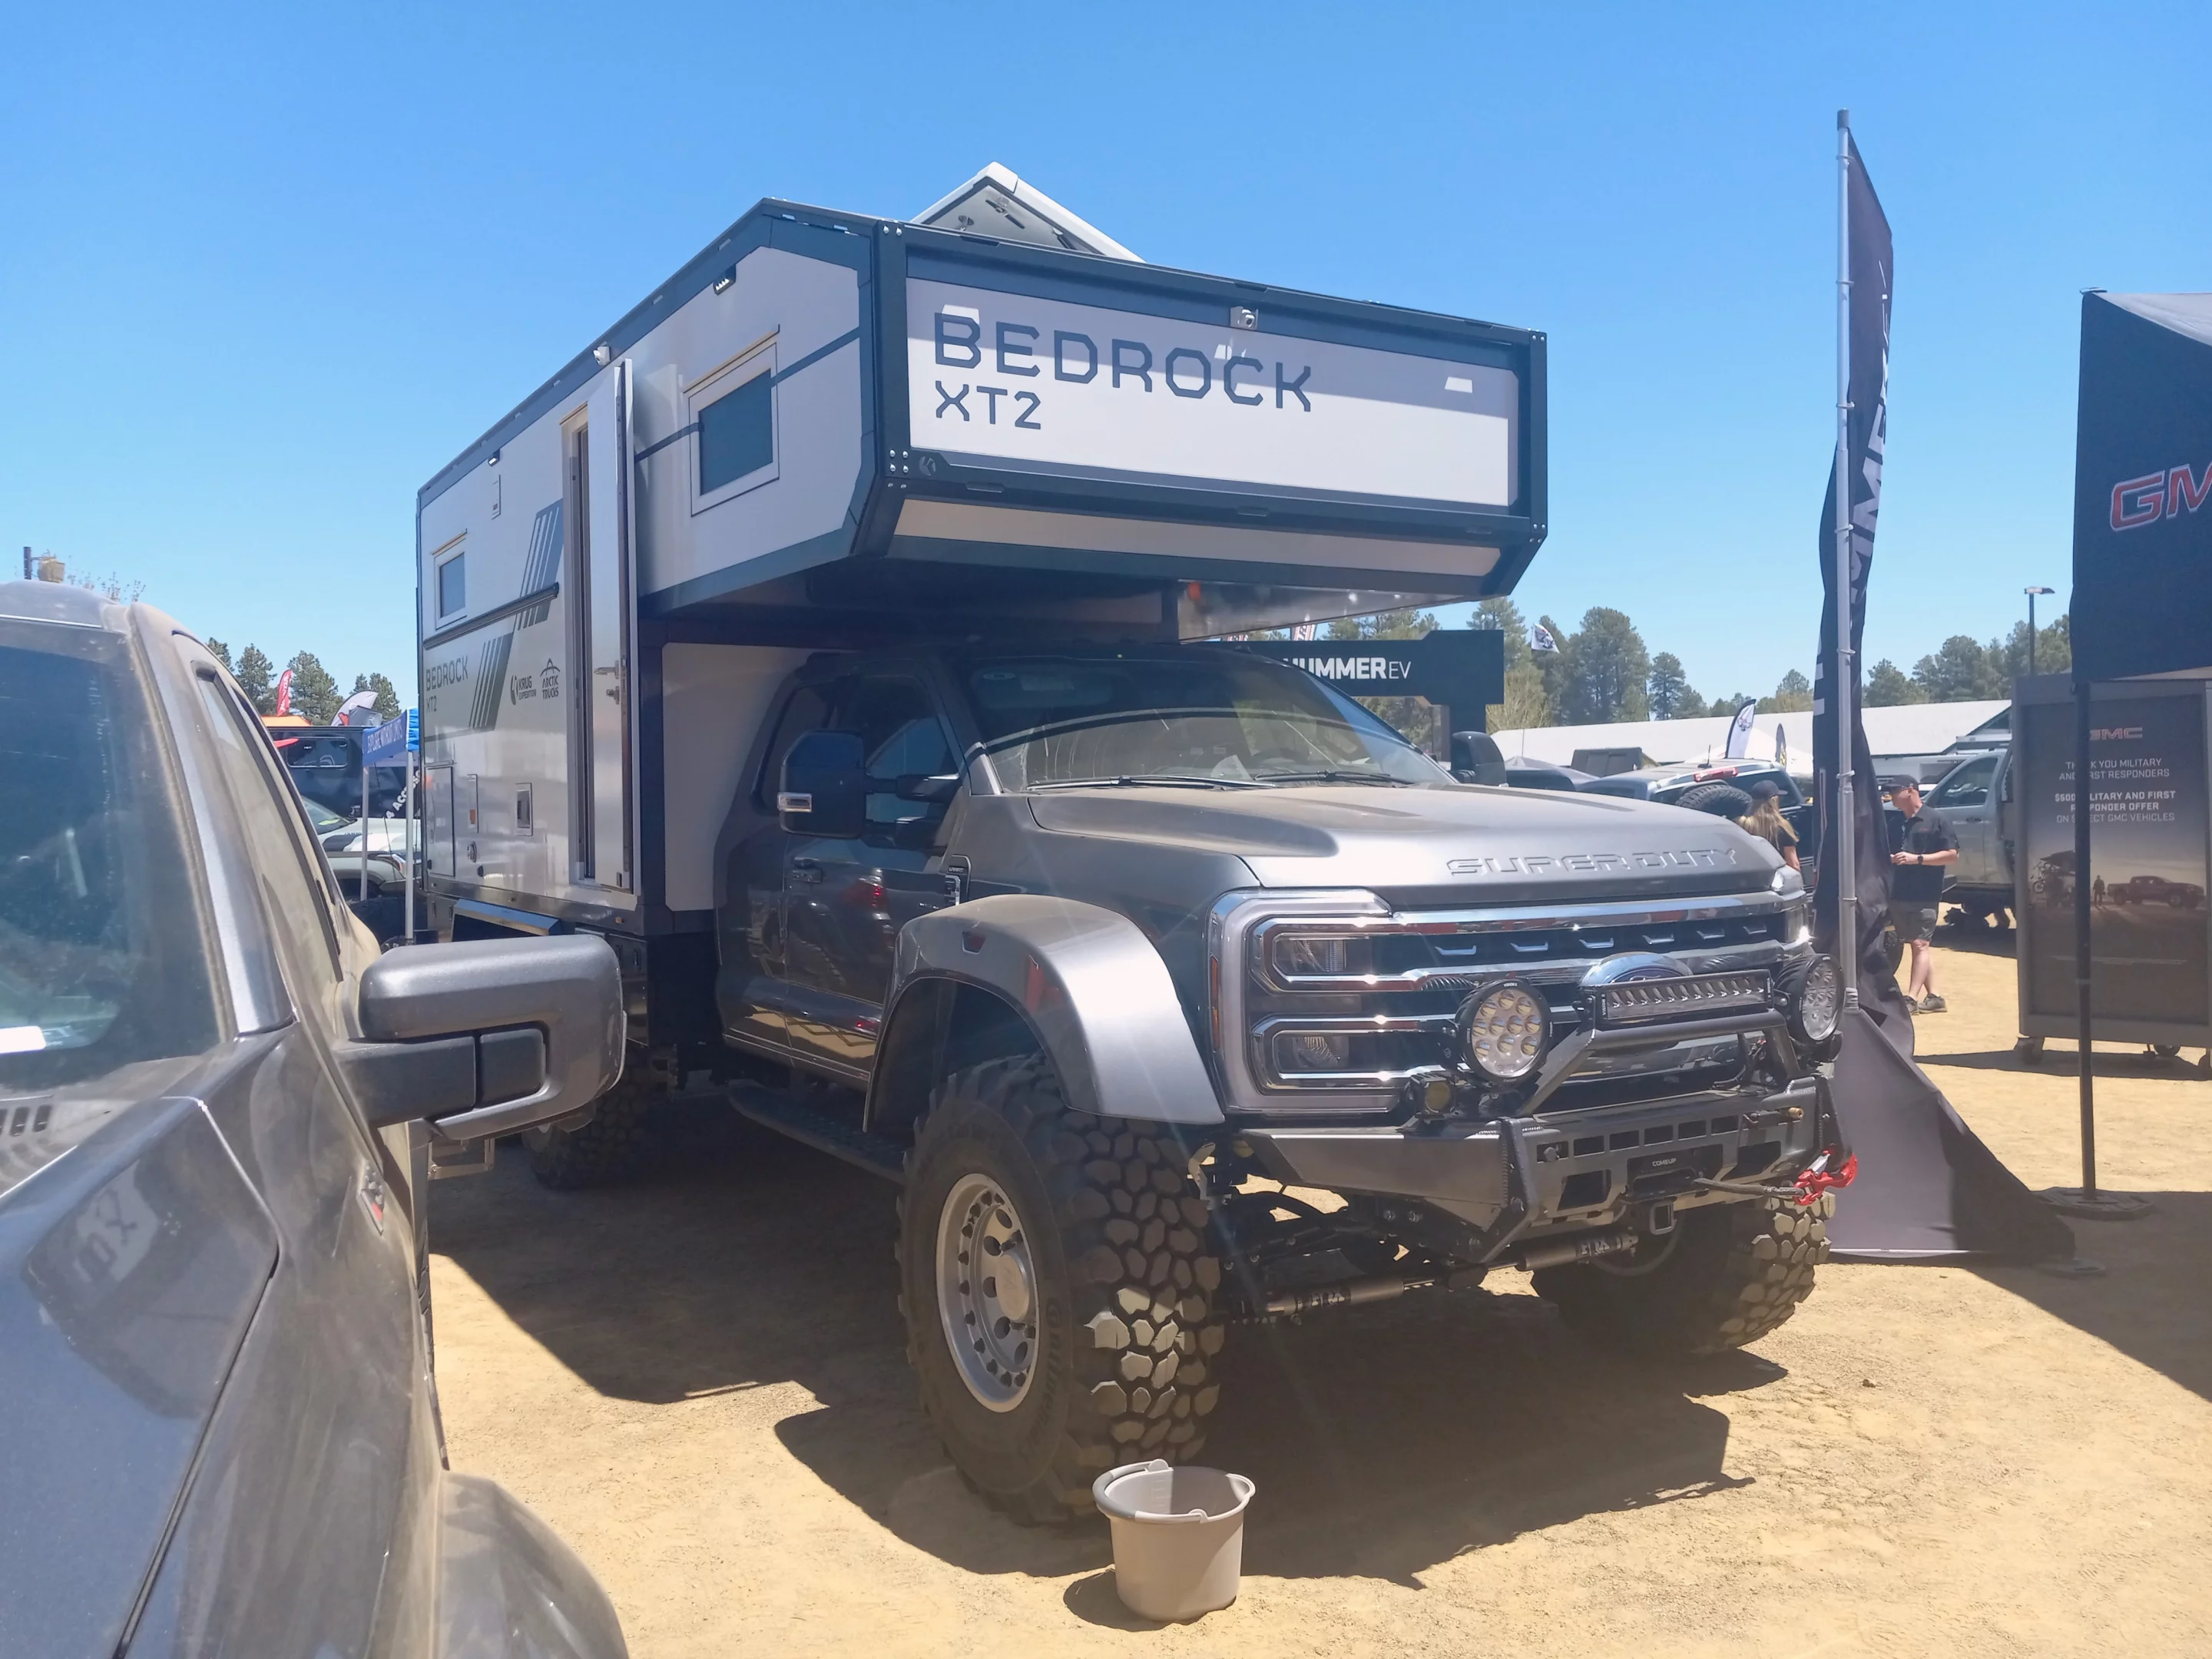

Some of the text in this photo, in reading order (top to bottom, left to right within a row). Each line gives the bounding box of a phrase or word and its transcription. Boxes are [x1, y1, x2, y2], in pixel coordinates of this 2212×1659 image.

[934, 312, 1312, 412] BEDROCK
[935, 380, 1041, 430] XT2
[426, 654, 469, 691] BEDROCK
[1283, 657, 1412, 679] UMMER EV
[518, 676, 532, 690] KRUG
[542, 675, 558, 688] ARCTIC
[542, 687, 559, 700] TRUCKS
[426, 695, 437, 713] XT2
[2098, 760, 2118, 769] YOU
[2120, 758, 2161, 768] MILITARY
[2108, 768, 2170, 779] RESPONDERS
[2089, 792, 2123, 801] LITARY
[2124, 791, 2145, 800] AND
[2147, 790, 2176, 800] FIRST
[2071, 802, 2159, 812] RPONDER OFFER
[2056, 815, 2068, 823] ON
[2108, 813, 2128, 822] GMC
[2130, 813, 2175, 822] VEHICLES
[1446, 848, 1737, 876] SUPER DUTY
[1652, 1157, 1677, 1167] COMEUP
